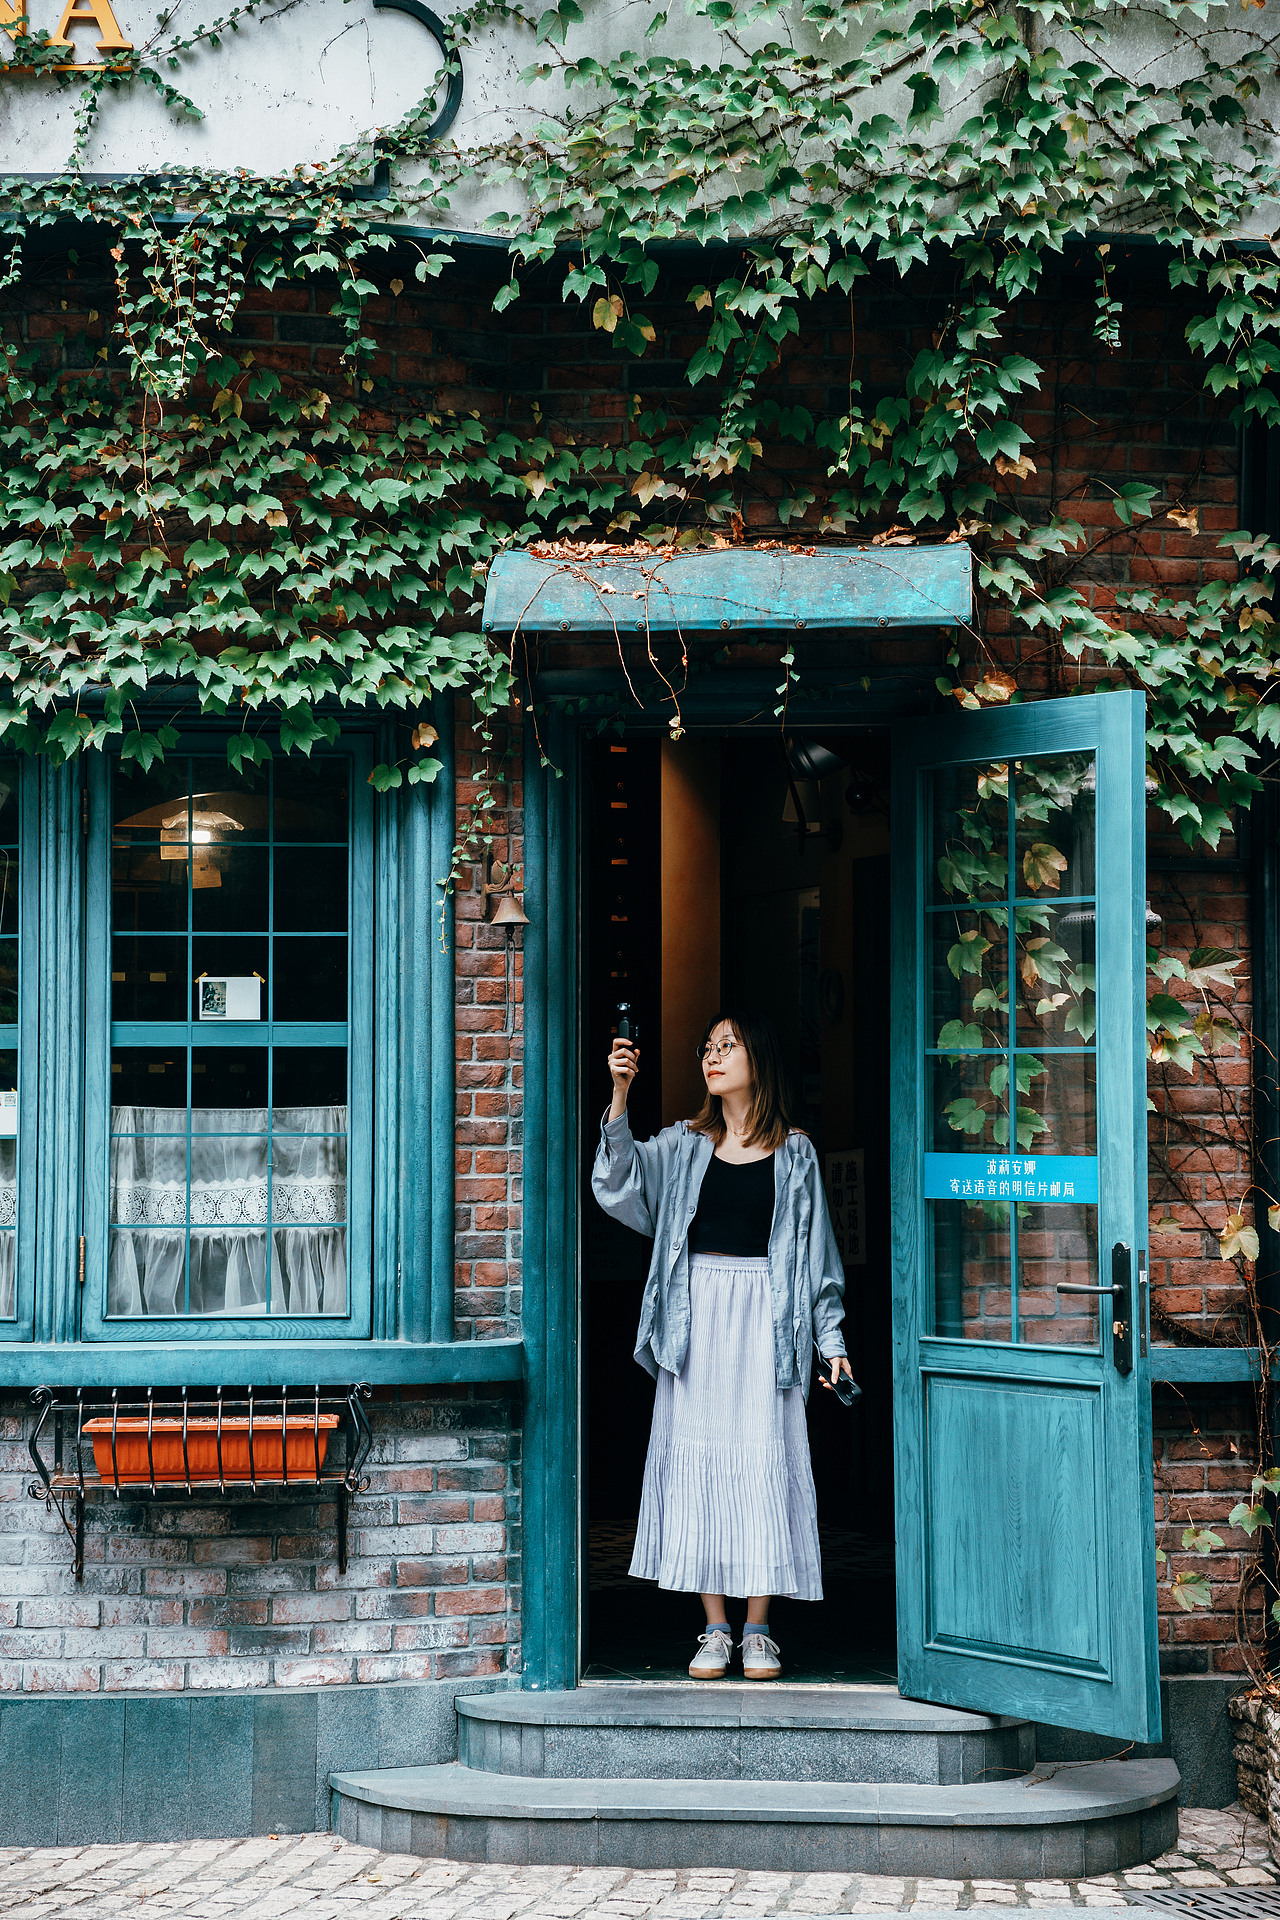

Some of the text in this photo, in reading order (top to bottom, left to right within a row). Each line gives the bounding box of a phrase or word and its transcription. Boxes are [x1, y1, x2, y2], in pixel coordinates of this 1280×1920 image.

[987, 1159, 1036, 1175] 波莉安娜
[949, 1178, 1074, 1197] 寄送语音的明信片邮局
